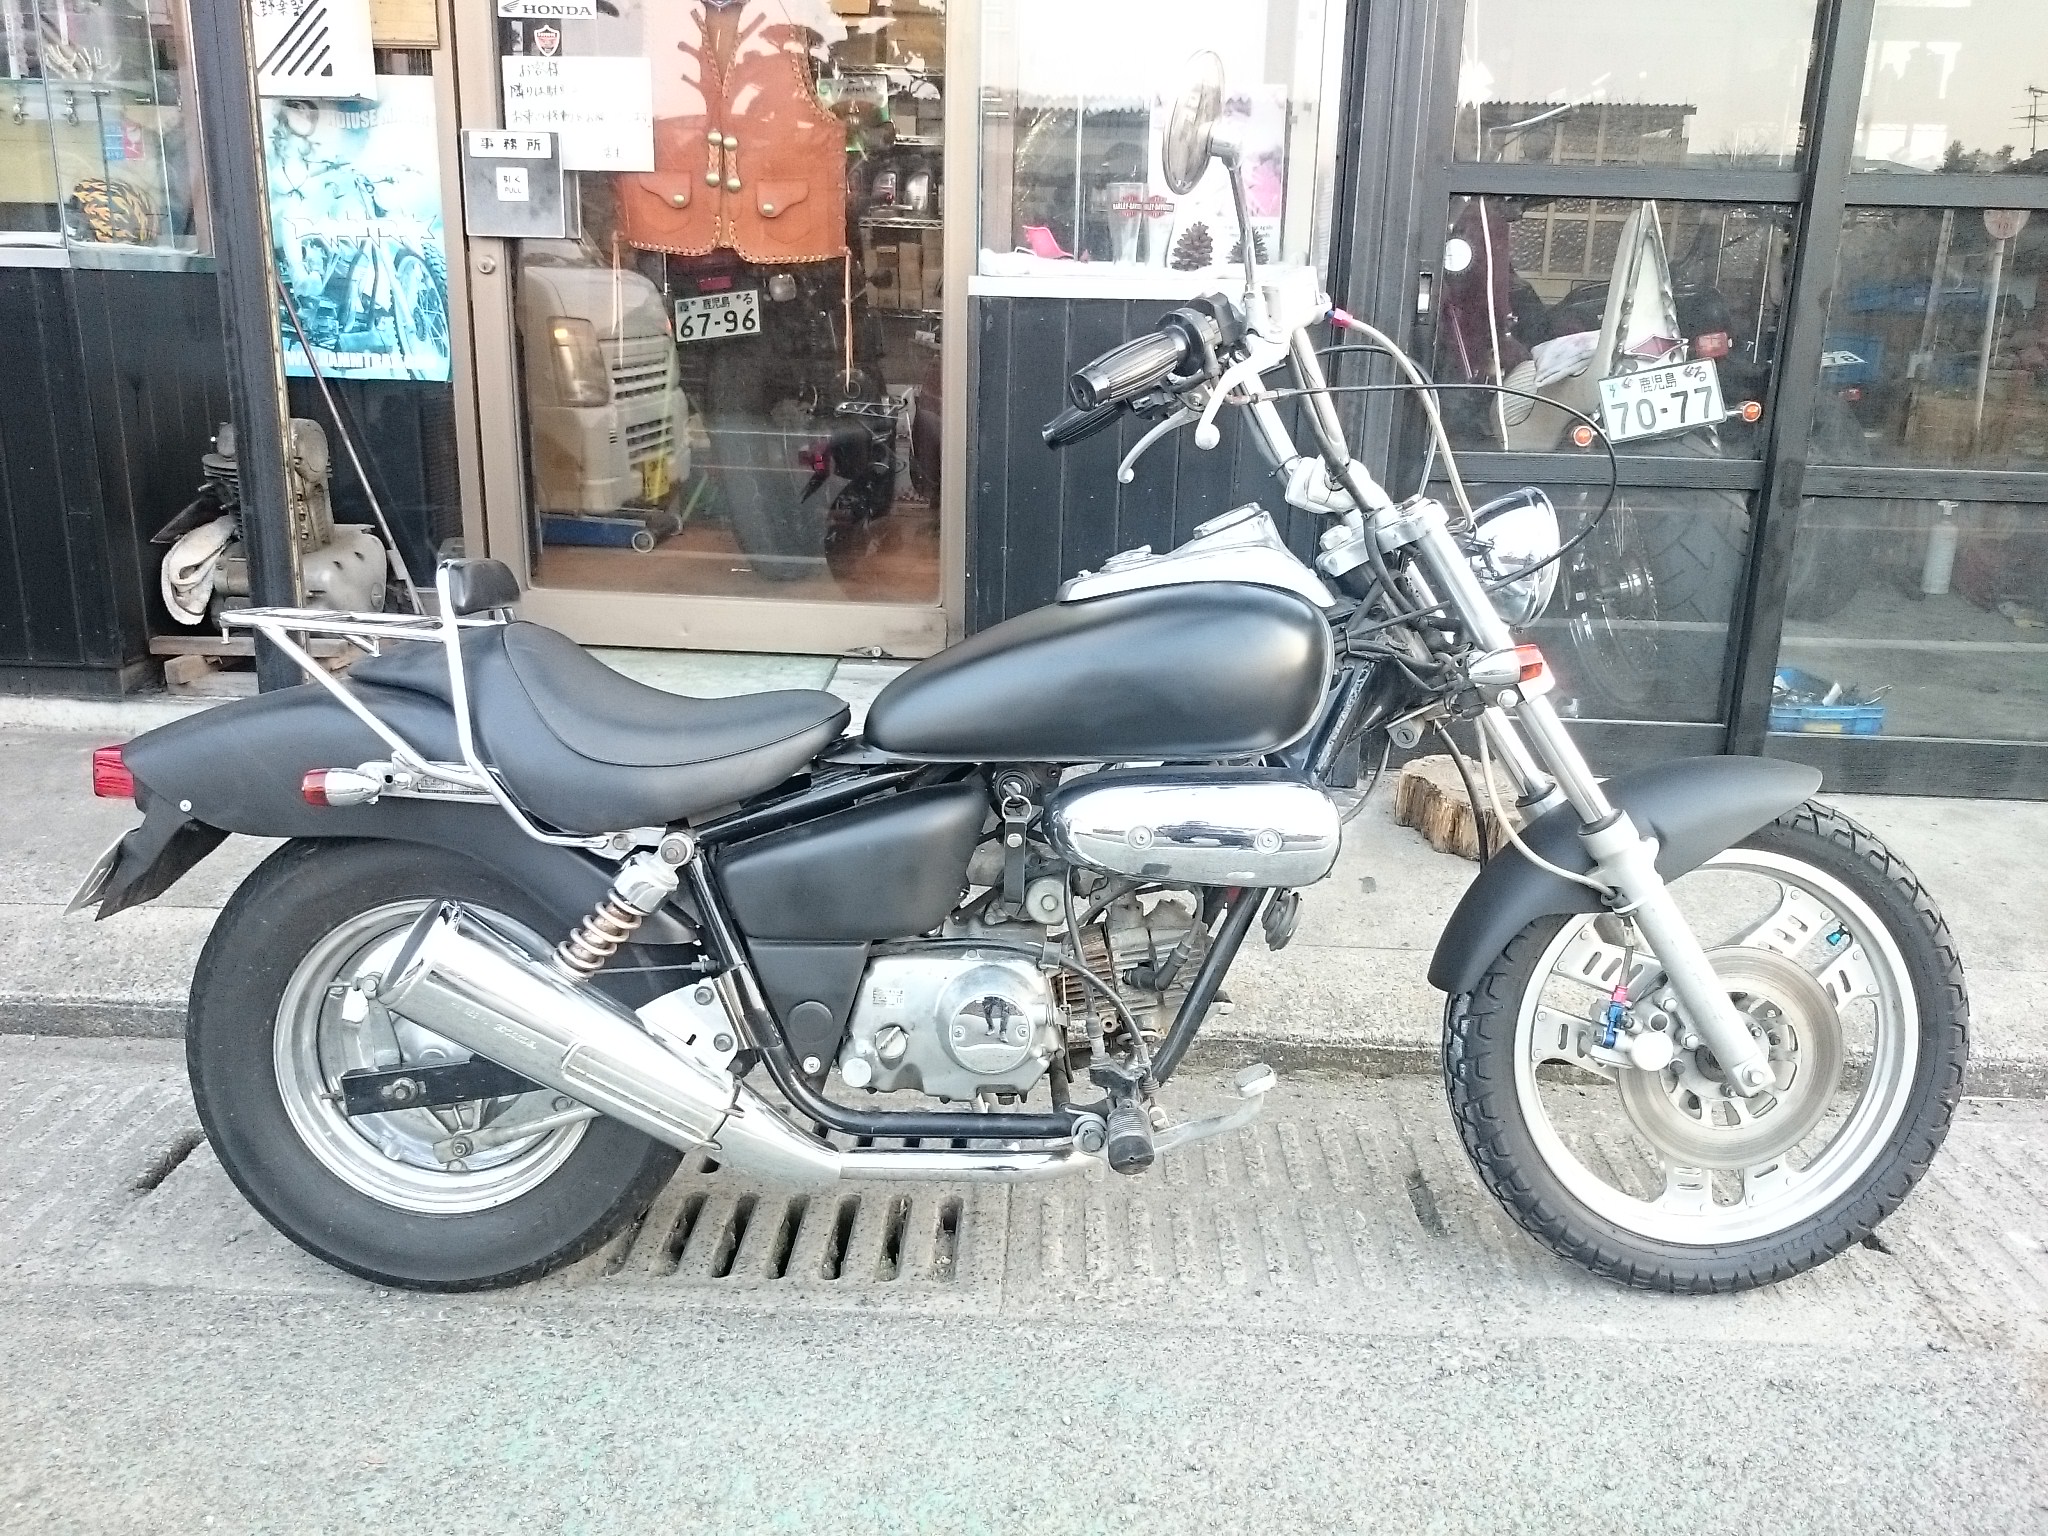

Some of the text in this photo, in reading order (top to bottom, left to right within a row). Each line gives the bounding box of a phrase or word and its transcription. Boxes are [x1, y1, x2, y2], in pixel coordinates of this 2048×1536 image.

[523, 5, 592, 16] HONDA
[480, 137, 541, 151] 事務所
[503, 175, 521, 184] 引く
[504, 186, 522, 194] PULL
[680, 308, 755, 338] 67-96
[1639, 372, 1677, 392] 鹿児島
[1694, 366, 1707, 382] る
[1611, 386, 1712, 435] 70-77
